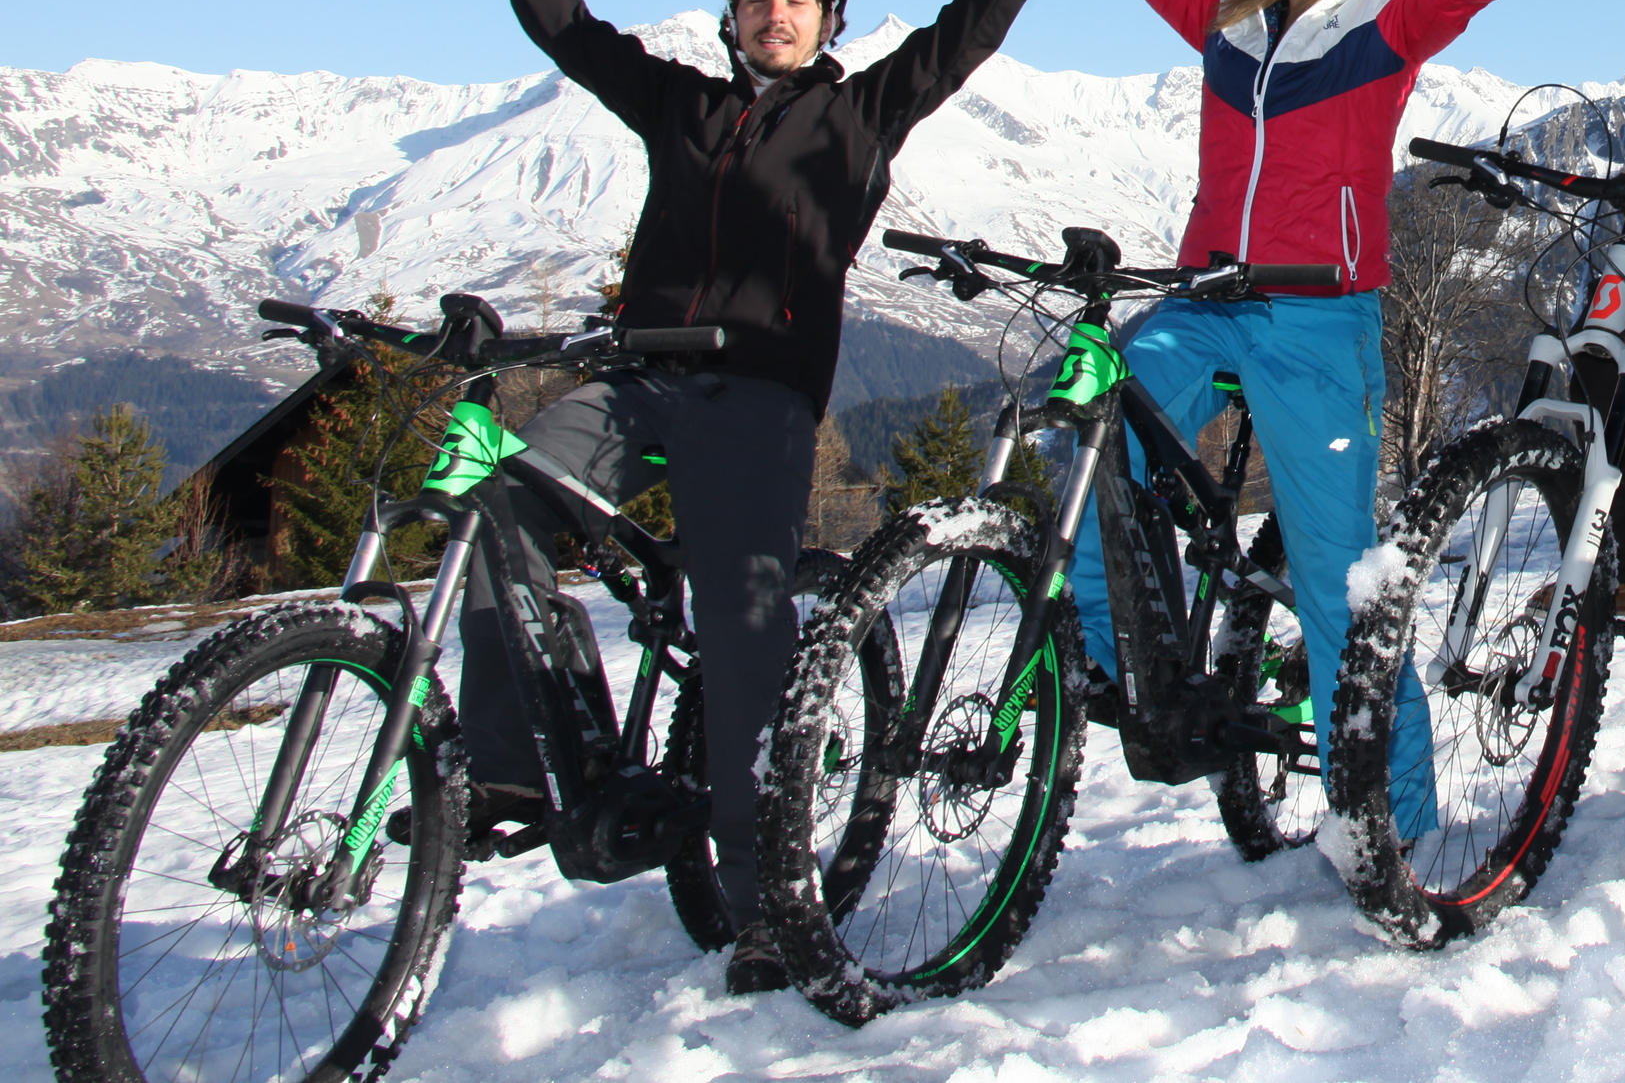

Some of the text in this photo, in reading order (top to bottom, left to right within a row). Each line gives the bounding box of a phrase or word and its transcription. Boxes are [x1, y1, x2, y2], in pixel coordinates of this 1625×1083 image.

[1329, 438, 1351, 452] 4F
[1549, 583, 1586, 654] FOX
[341, 974, 423, 1083] MAX
